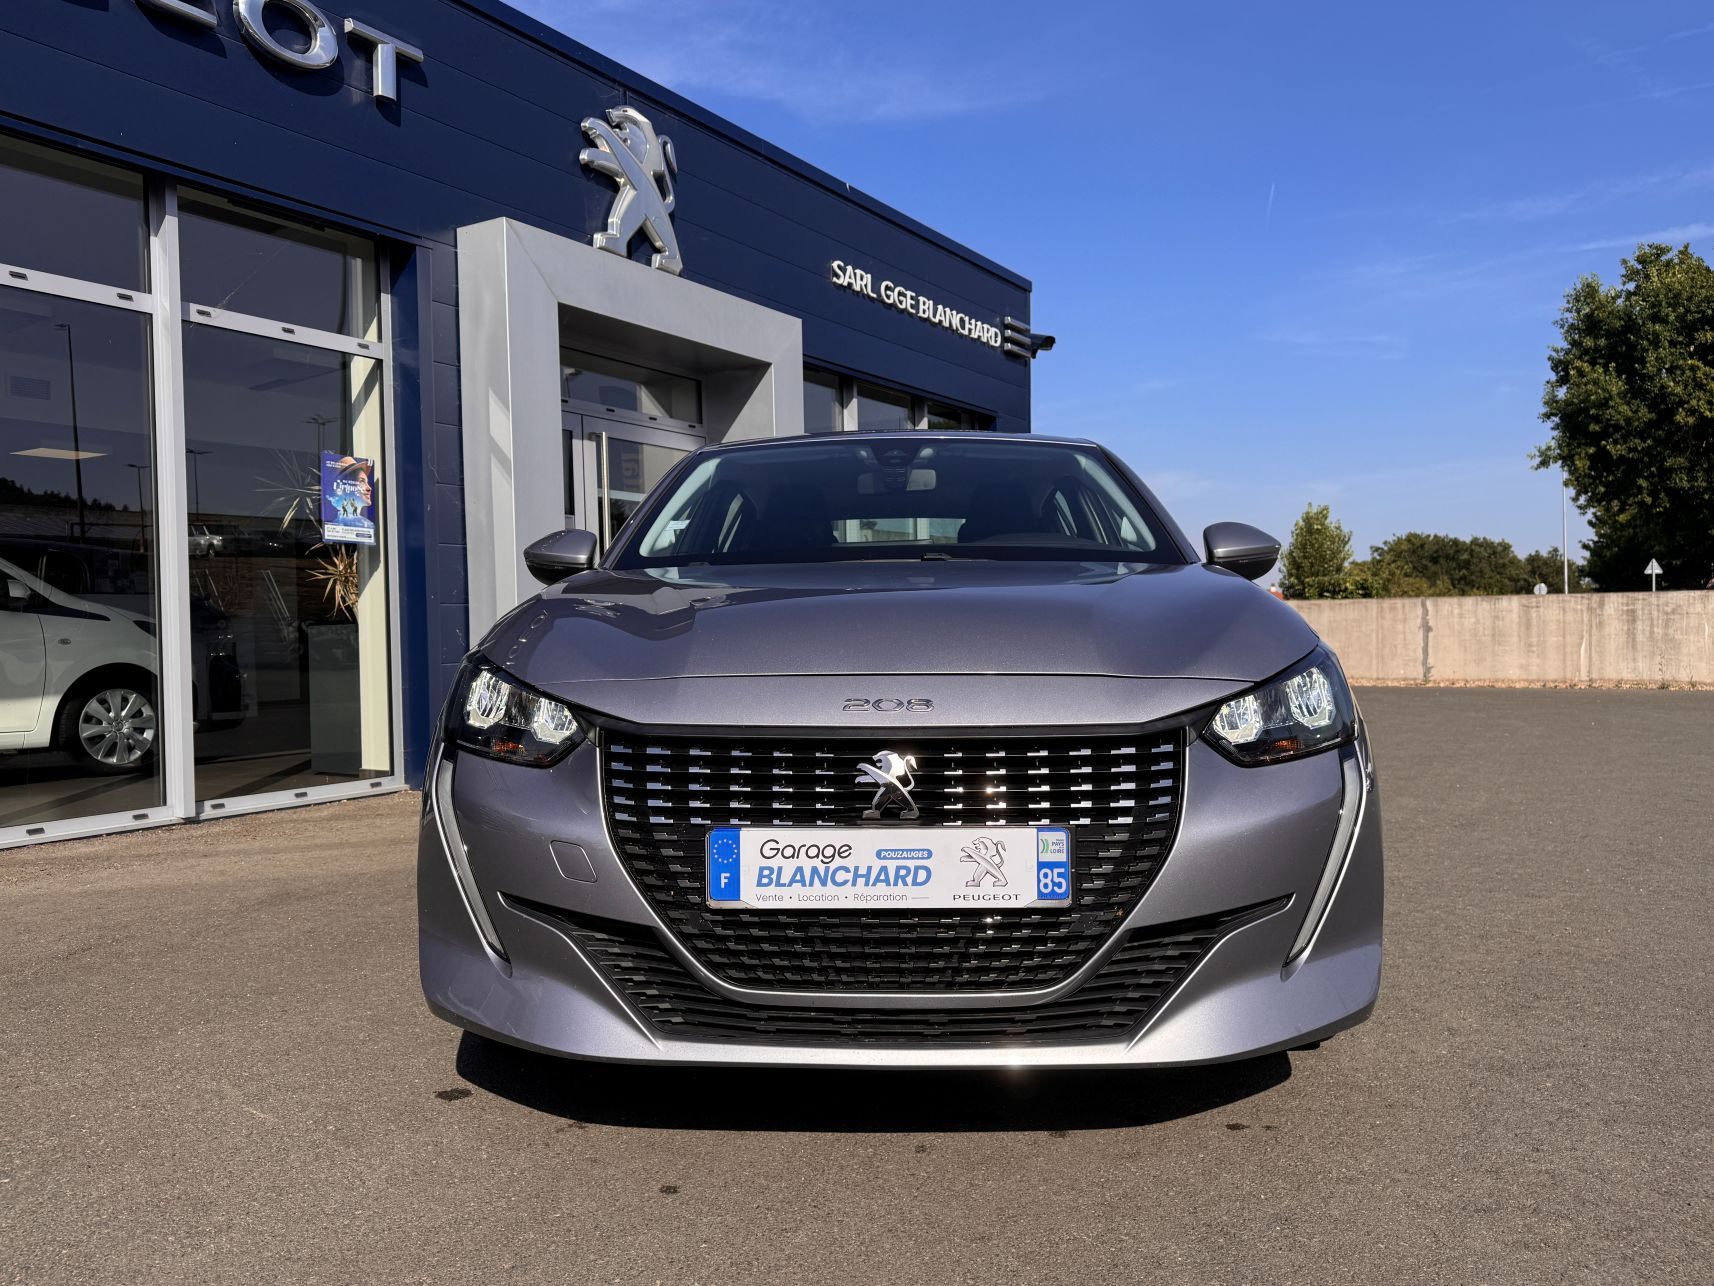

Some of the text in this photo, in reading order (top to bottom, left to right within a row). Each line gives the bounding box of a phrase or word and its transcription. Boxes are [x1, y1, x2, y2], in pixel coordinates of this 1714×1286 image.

[133, 0, 424, 101] OT
[831, 260, 1002, 348] SARL GGE BLANCHARD
[842, 698, 935, 713] 208
[759, 838, 853, 865] Garage
[880, 850, 929, 858] POUZAUGES
[720, 872, 731, 889] F
[756, 864, 933, 888] BLANCHARD
[1039, 867, 1067, 894] 85
[755, 892, 908, 904] Vente Location Réparation
[952, 893, 1021, 902] PEUGEOT
